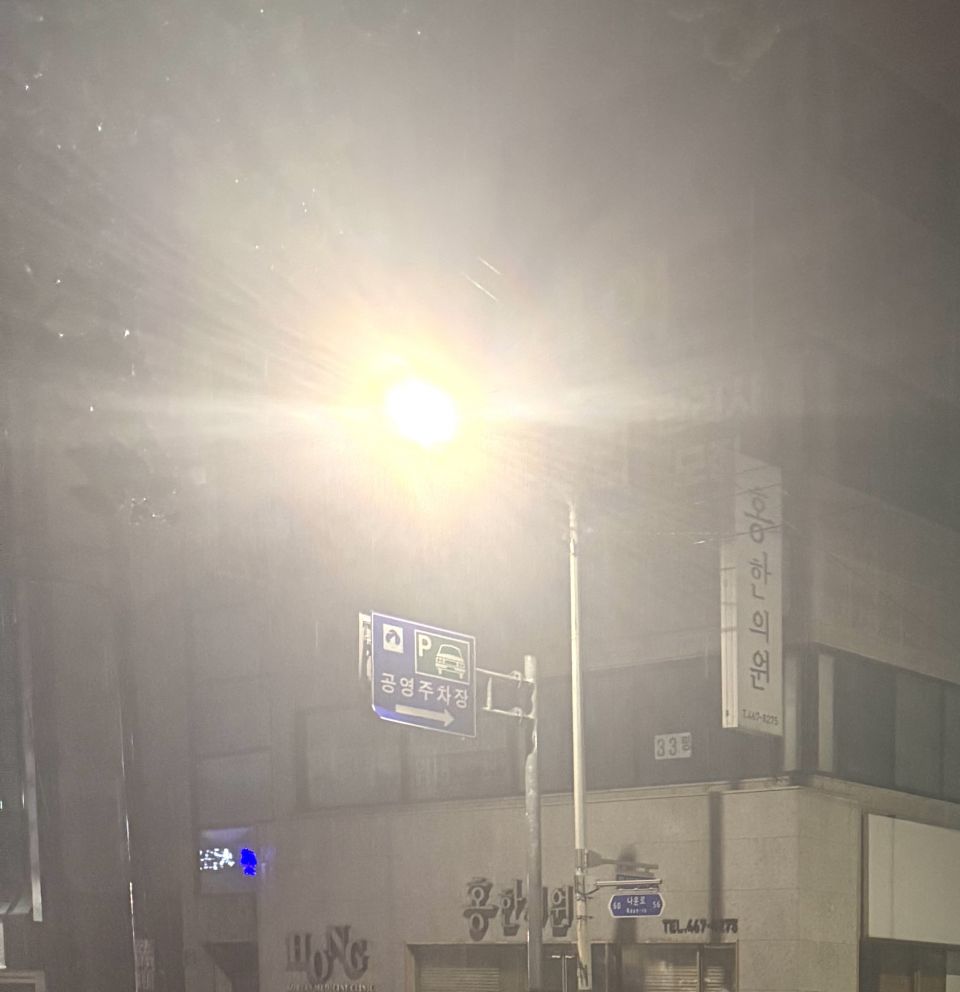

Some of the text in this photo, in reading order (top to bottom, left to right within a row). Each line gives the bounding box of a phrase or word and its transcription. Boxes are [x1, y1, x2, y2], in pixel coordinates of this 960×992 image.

[744, 486, 772, 692] 홍한의원
[417, 634, 432, 657] P
[380, 672, 469, 709] 공영주차장
